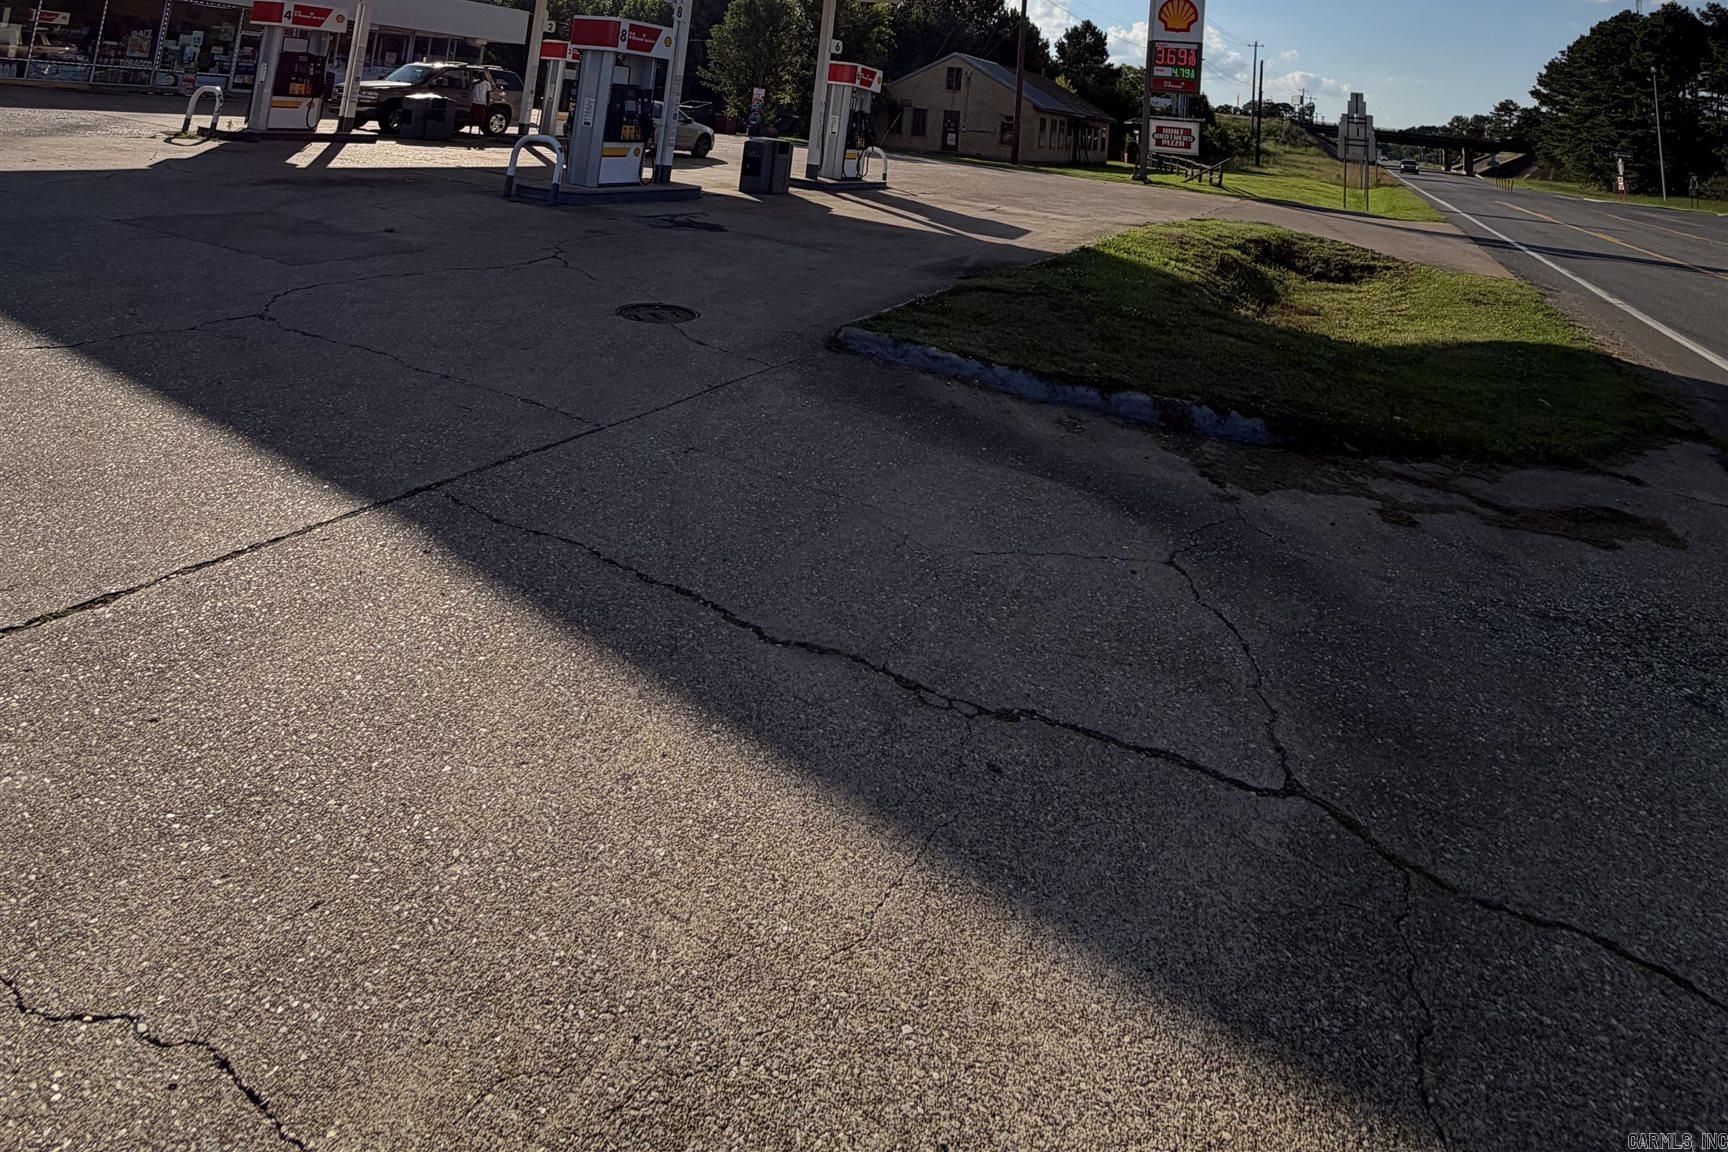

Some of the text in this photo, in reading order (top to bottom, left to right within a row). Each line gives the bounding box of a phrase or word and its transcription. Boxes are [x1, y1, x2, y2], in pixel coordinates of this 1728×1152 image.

[284, 11, 291, 20] 4
[676, 7, 683, 18] 8
[547, 23, 553, 31] 2
[620, 28, 627, 43] 8
[835, 42, 841, 52] 6
[1155, 47, 1188, 66] 3.69
[1172, 68, 1190, 78] 4.79
[1162, 127, 1184, 135] HUNT
